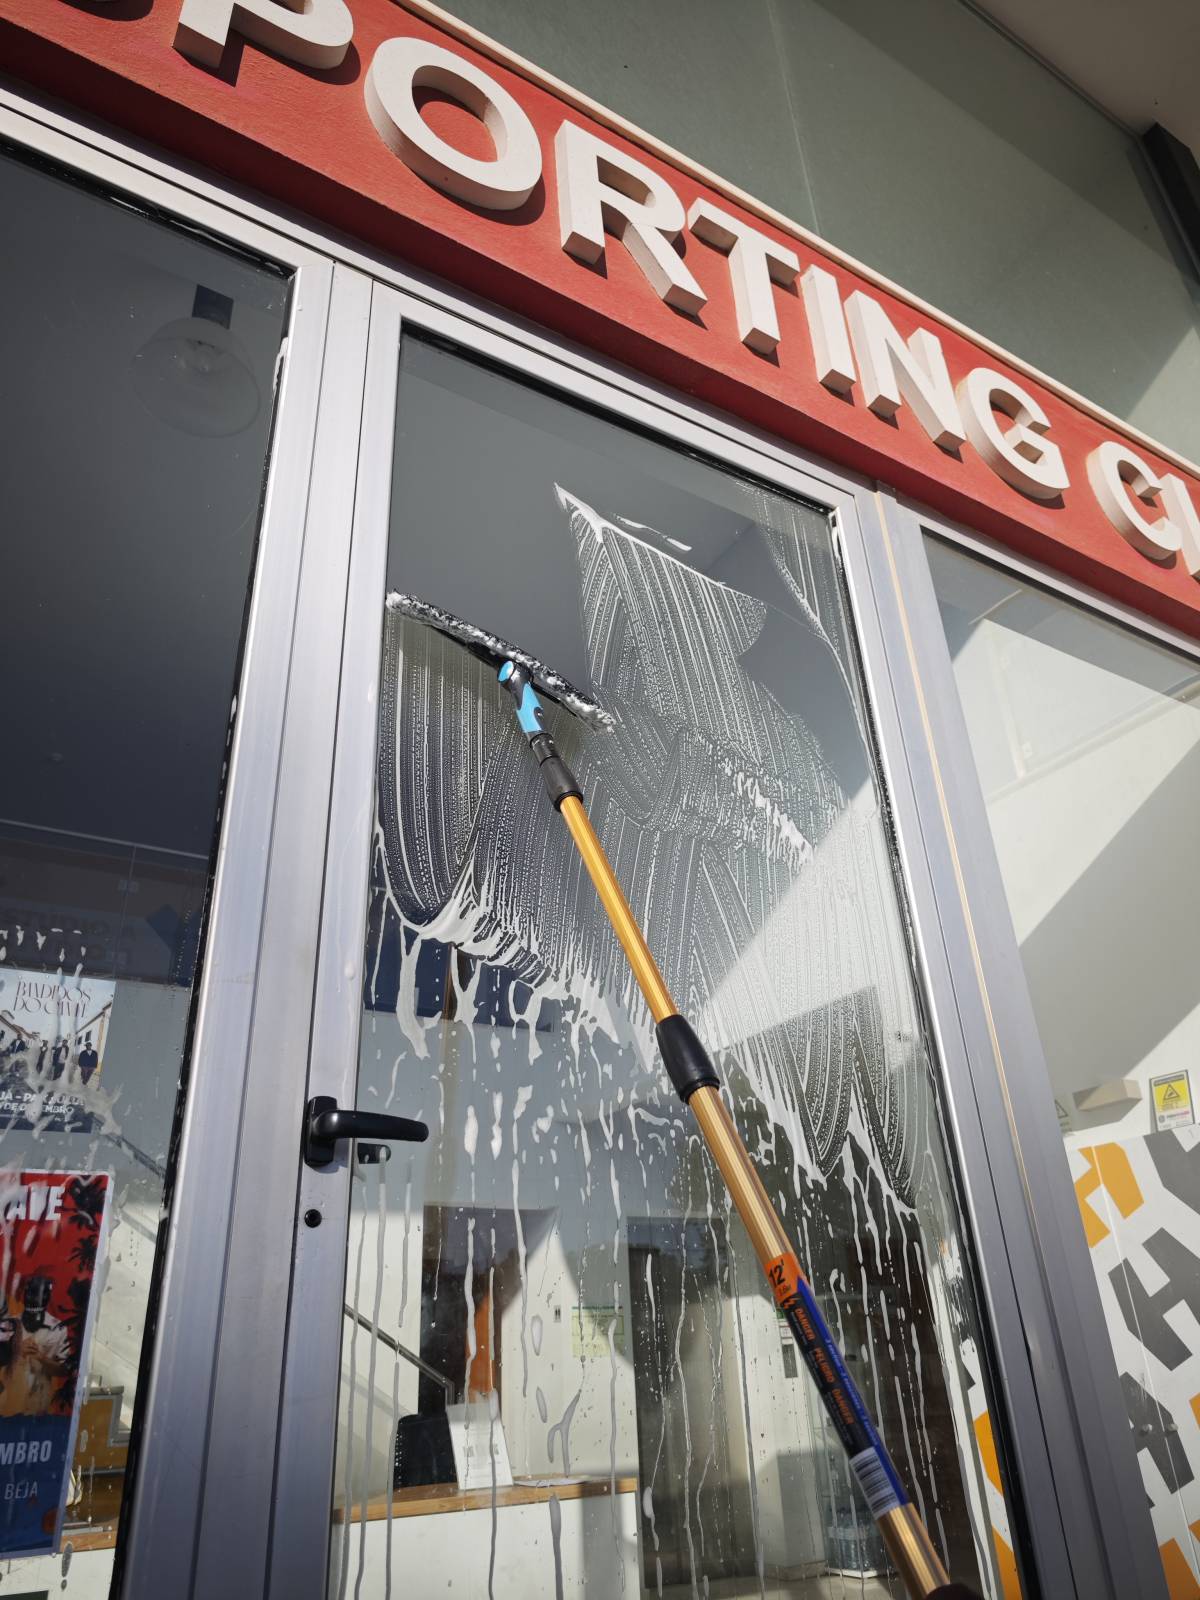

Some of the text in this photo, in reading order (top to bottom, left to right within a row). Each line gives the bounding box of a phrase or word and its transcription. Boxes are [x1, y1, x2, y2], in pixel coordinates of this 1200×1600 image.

[794, 1307, 816, 1341] DANGER
[814, 1347, 835, 1383] PELIGRO
[832, 1388, 854, 1425] DANGER
